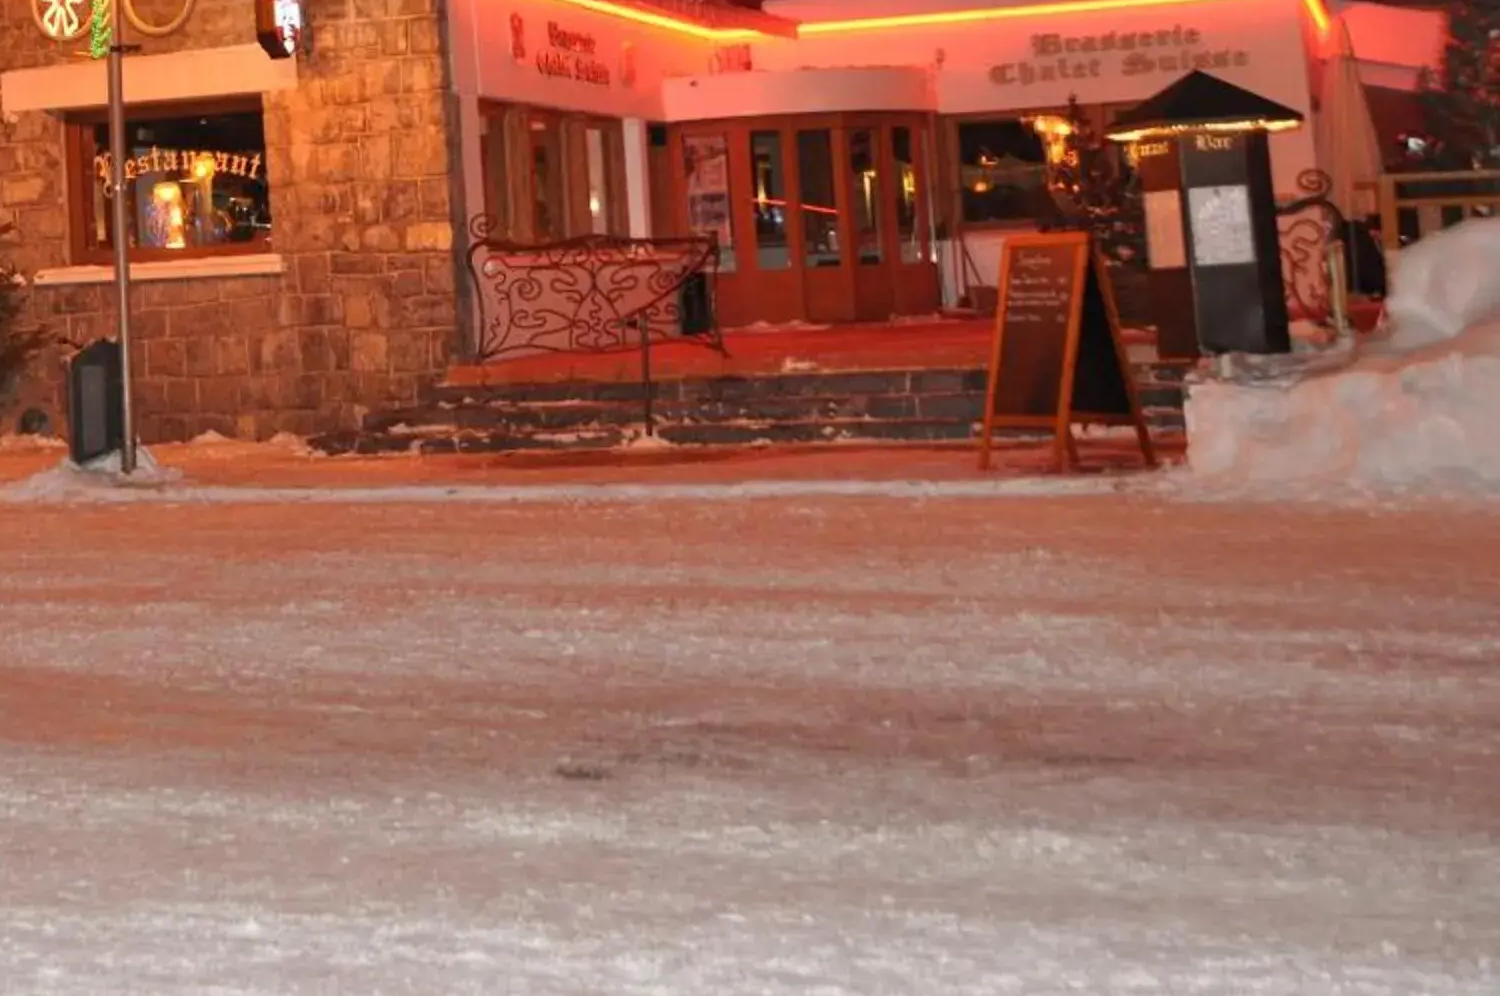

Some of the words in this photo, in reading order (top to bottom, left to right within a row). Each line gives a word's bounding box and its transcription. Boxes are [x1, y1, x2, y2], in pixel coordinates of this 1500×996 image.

[1030, 23, 1200, 56] Brasserie
[988, 57, 1101, 86] Chalet
[1120, 47, 1249, 77] Suisse
